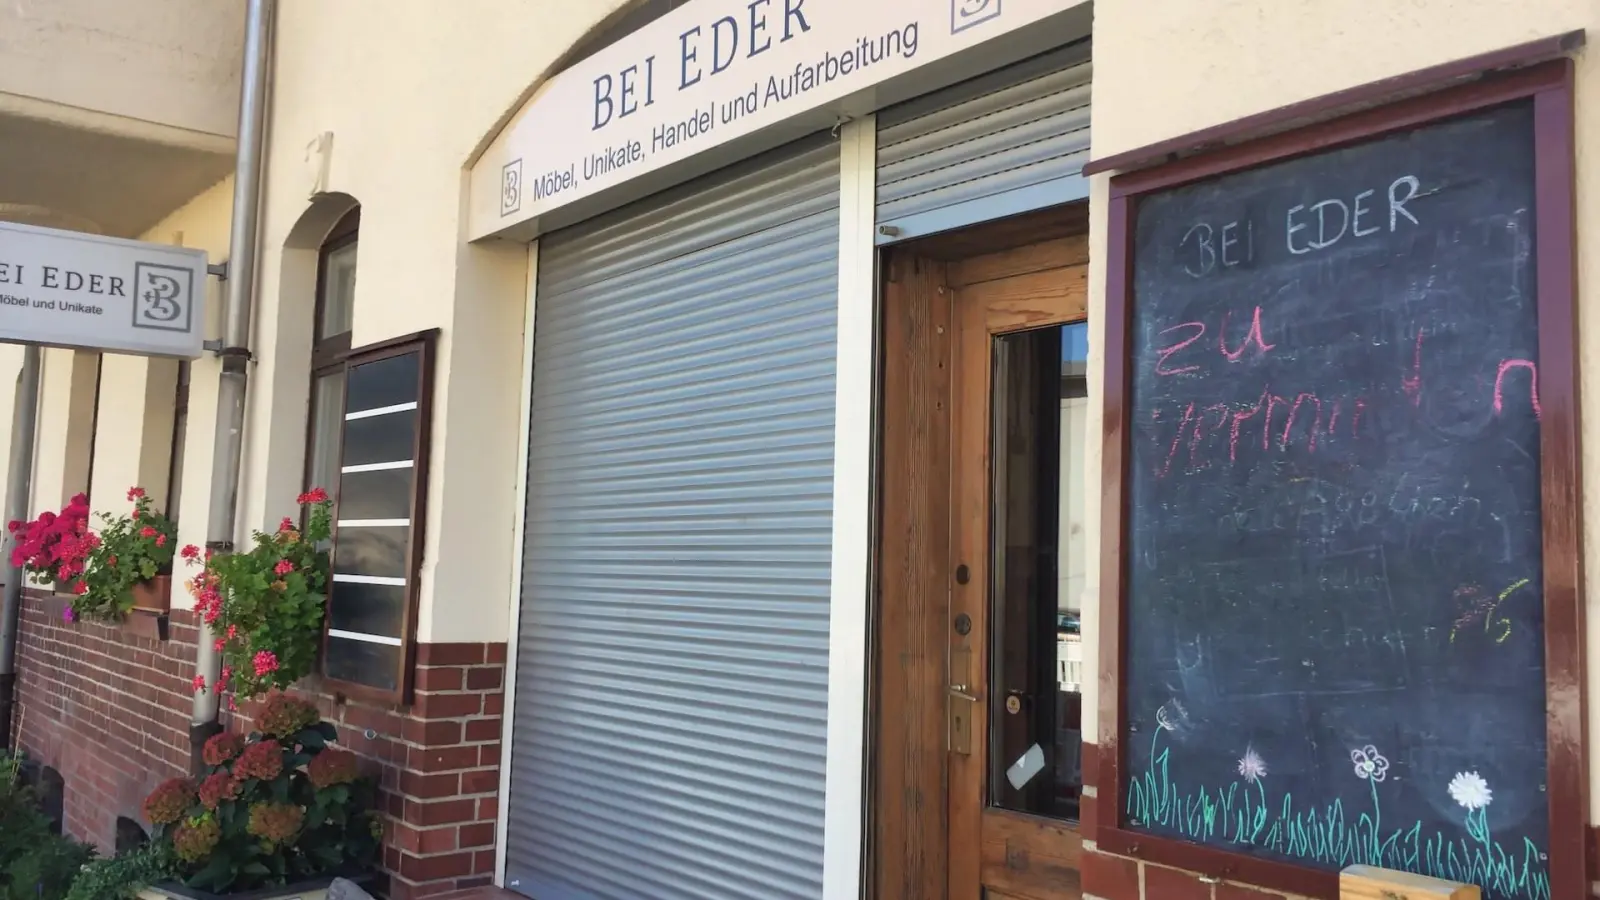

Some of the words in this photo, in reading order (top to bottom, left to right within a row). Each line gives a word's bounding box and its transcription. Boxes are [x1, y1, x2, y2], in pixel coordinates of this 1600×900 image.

[533, 163, 578, 202] Möbel,
[584, 139, 646, 181] Unikate,
[652, 102, 715, 154] Handel
[721, 82, 758, 124] und
[763, 20, 919, 108] Aufarbeitung
[592, 56, 655, 131] BEI
[678, 0, 811, 92] EDER
[1179, 220, 1254, 279] BEI
[1286, 174, 1420, 255] EDER
[0, 294, 29, 307] öbel
[32, 299, 55, 310] und
[59, 301, 103, 315] Unikate
[41, 266, 126, 297] EDER
